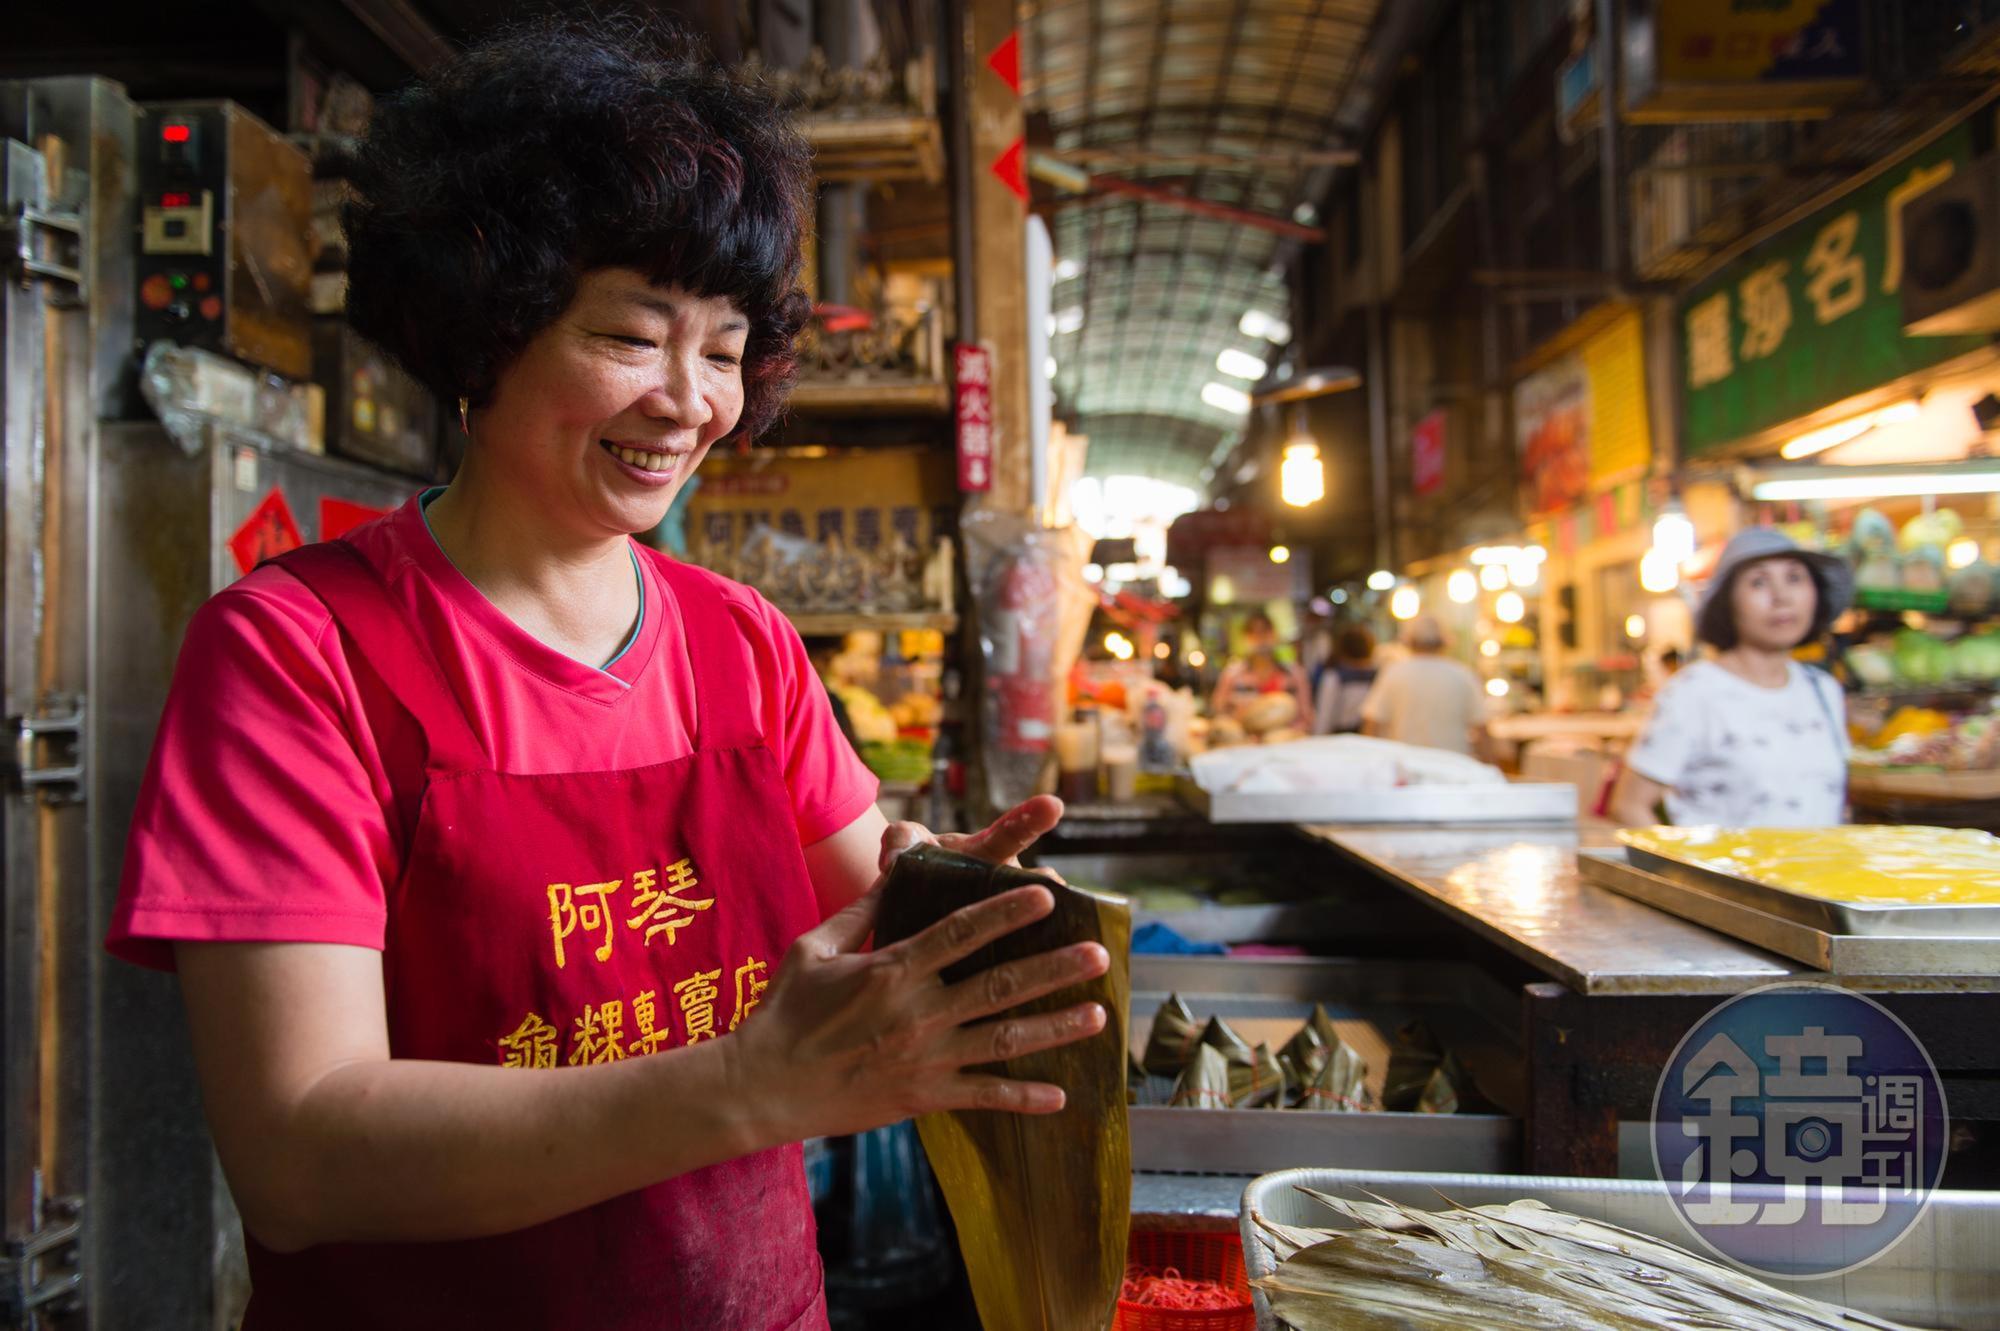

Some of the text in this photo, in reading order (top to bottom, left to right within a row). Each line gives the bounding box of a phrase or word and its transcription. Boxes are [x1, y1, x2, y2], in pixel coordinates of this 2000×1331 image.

[958, 352, 989, 457] 滅火器
[547, 858, 715, 968] 阿琴
